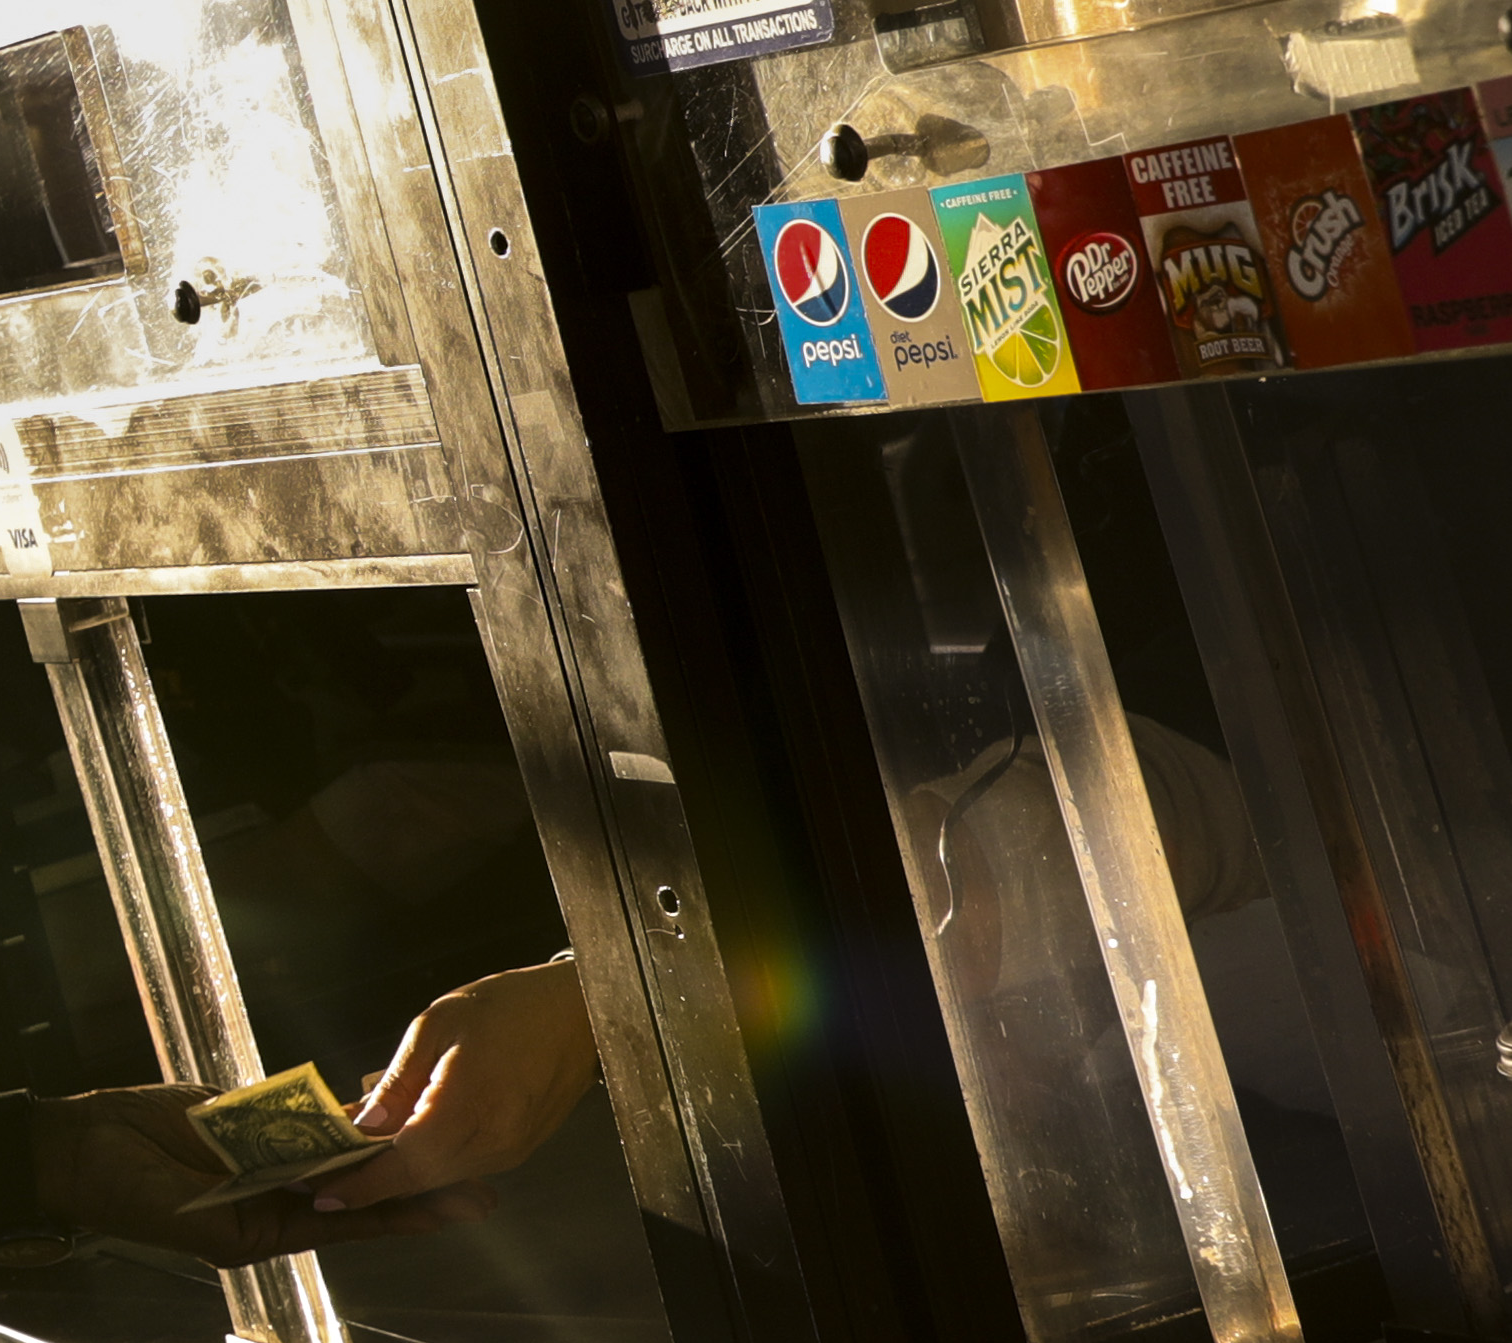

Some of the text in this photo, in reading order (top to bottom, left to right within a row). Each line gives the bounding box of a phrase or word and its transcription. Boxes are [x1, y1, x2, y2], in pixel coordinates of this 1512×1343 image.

[630, 8, 818, 65] SURCHARGE ON ALL TRANSACTIONS
[1130, 140, 1233, 185] CAFFEINE
[945, 187, 1014, 210] CAFFEINE FREE
[1161, 175, 1218, 210] FREE
[1433, 185, 1490, 248] ICED TEA
[960, 219, 1028, 296] SIERRA
[1085, 237, 1113, 270] Dr
[1287, 188, 1364, 299] Crush
[965, 236, 1049, 354] MIST
[1067, 249, 1134, 304] Pepper
[1162, 243, 1264, 315] MUG
[802, 333, 862, 368] pepsi
[890, 329, 913, 346] diet
[894, 334, 956, 372] pepsi
[1199, 336, 1266, 361] ROOT BEER
[7, 528, 39, 550] VISA
